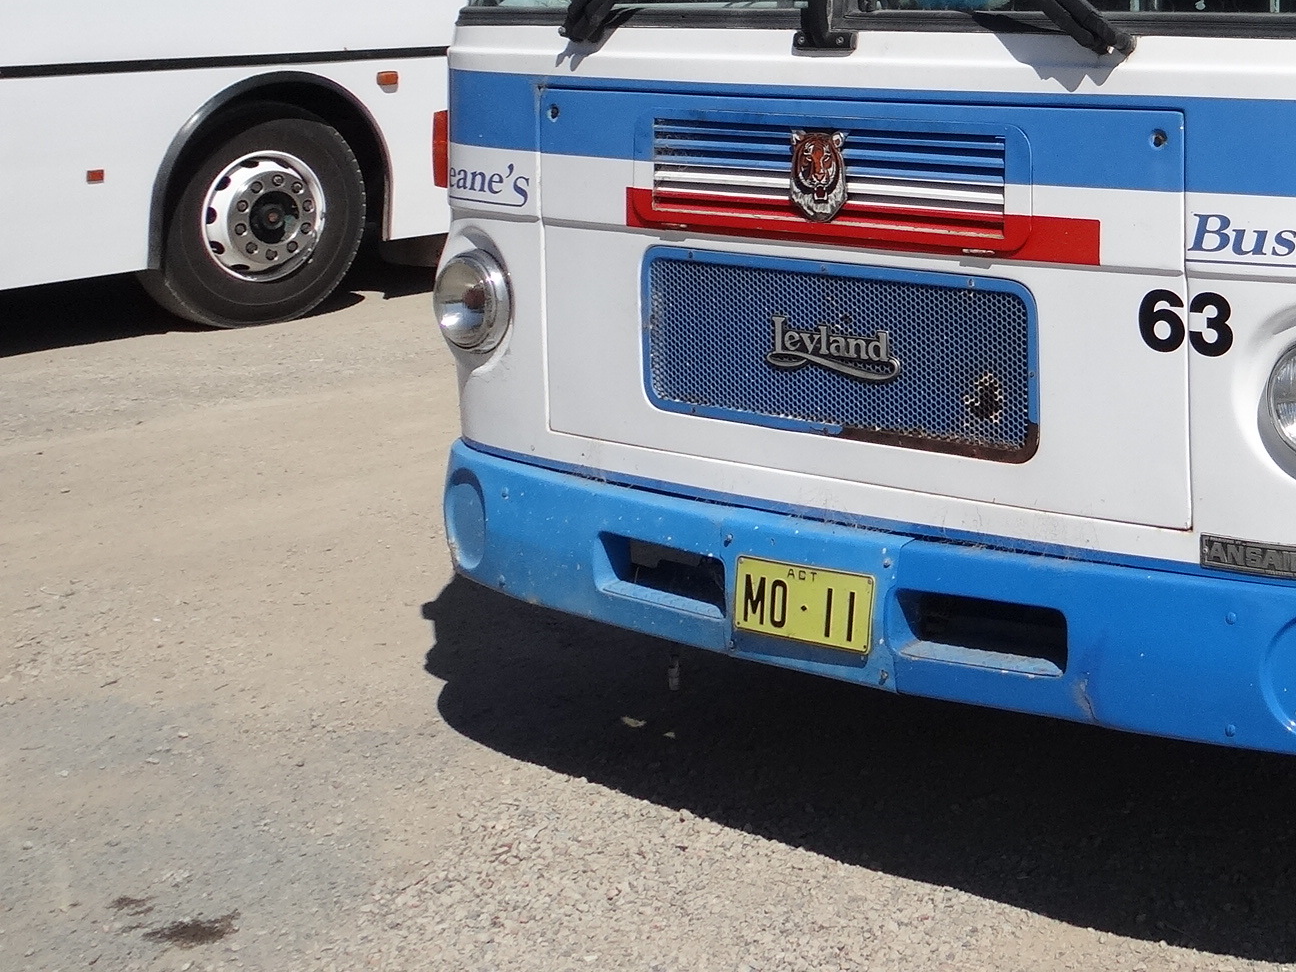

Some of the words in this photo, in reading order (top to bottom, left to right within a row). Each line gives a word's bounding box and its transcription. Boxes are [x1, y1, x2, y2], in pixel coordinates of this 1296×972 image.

[768, 315, 898, 375] Leyland
[1138, 288, 1234, 358] 63
[786, 568, 818, 582] ACT
